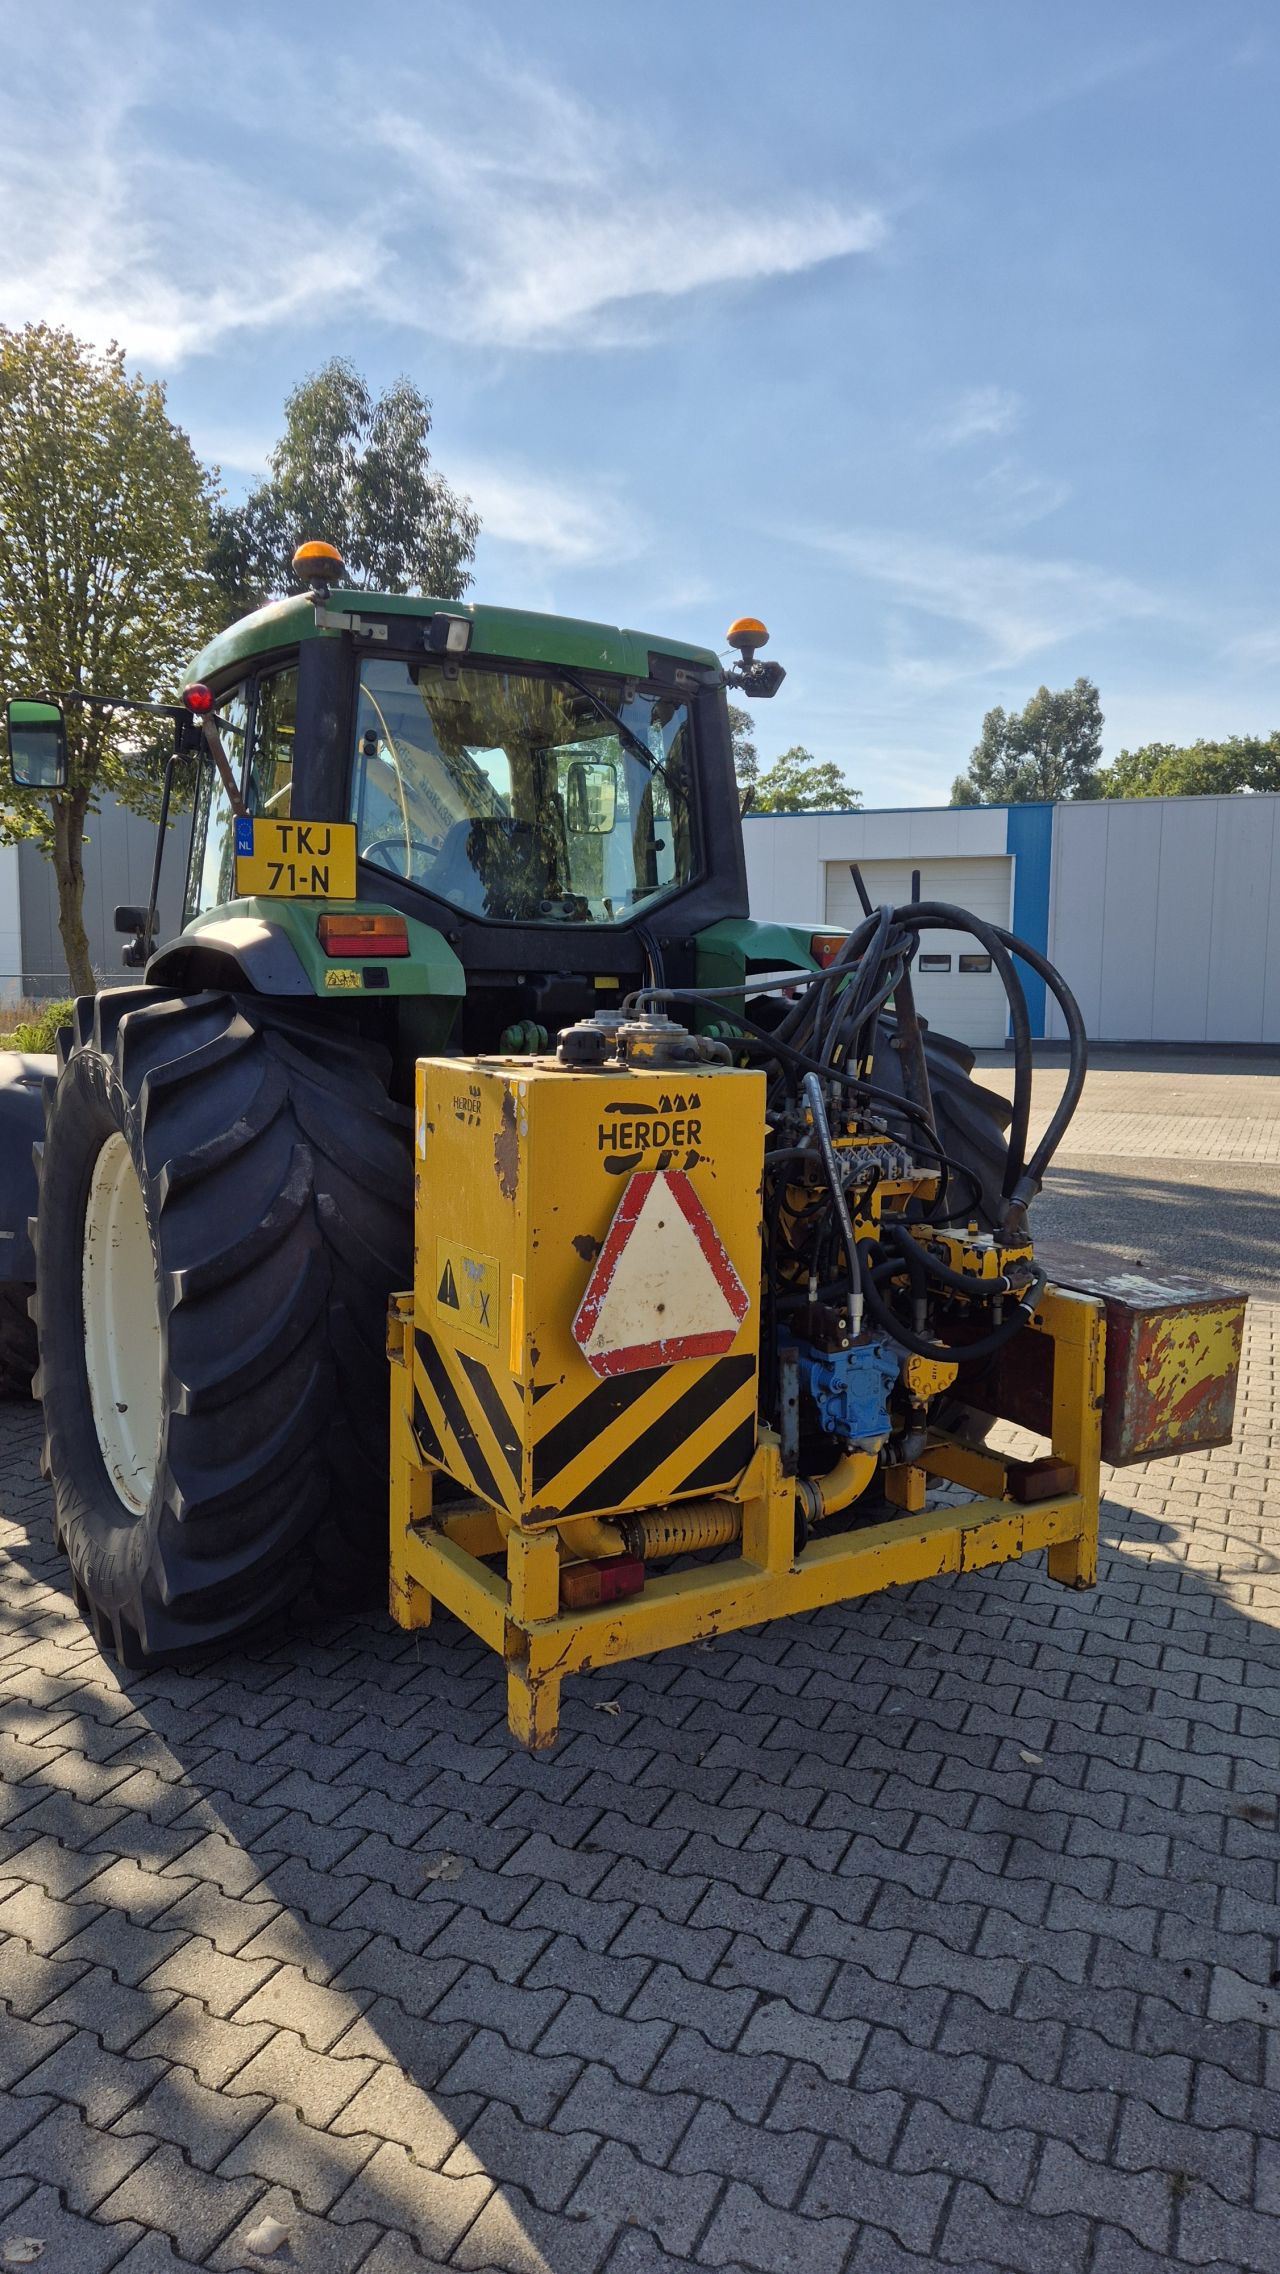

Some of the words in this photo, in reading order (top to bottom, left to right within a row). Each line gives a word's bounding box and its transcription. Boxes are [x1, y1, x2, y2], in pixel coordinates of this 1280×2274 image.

[238, 840, 252, 851] NL
[276, 824, 331, 856] TKJ
[267, 862, 329, 893] 71-N
[453, 1095, 482, 1114] HERDER
[598, 1119, 702, 1151] HERDER
